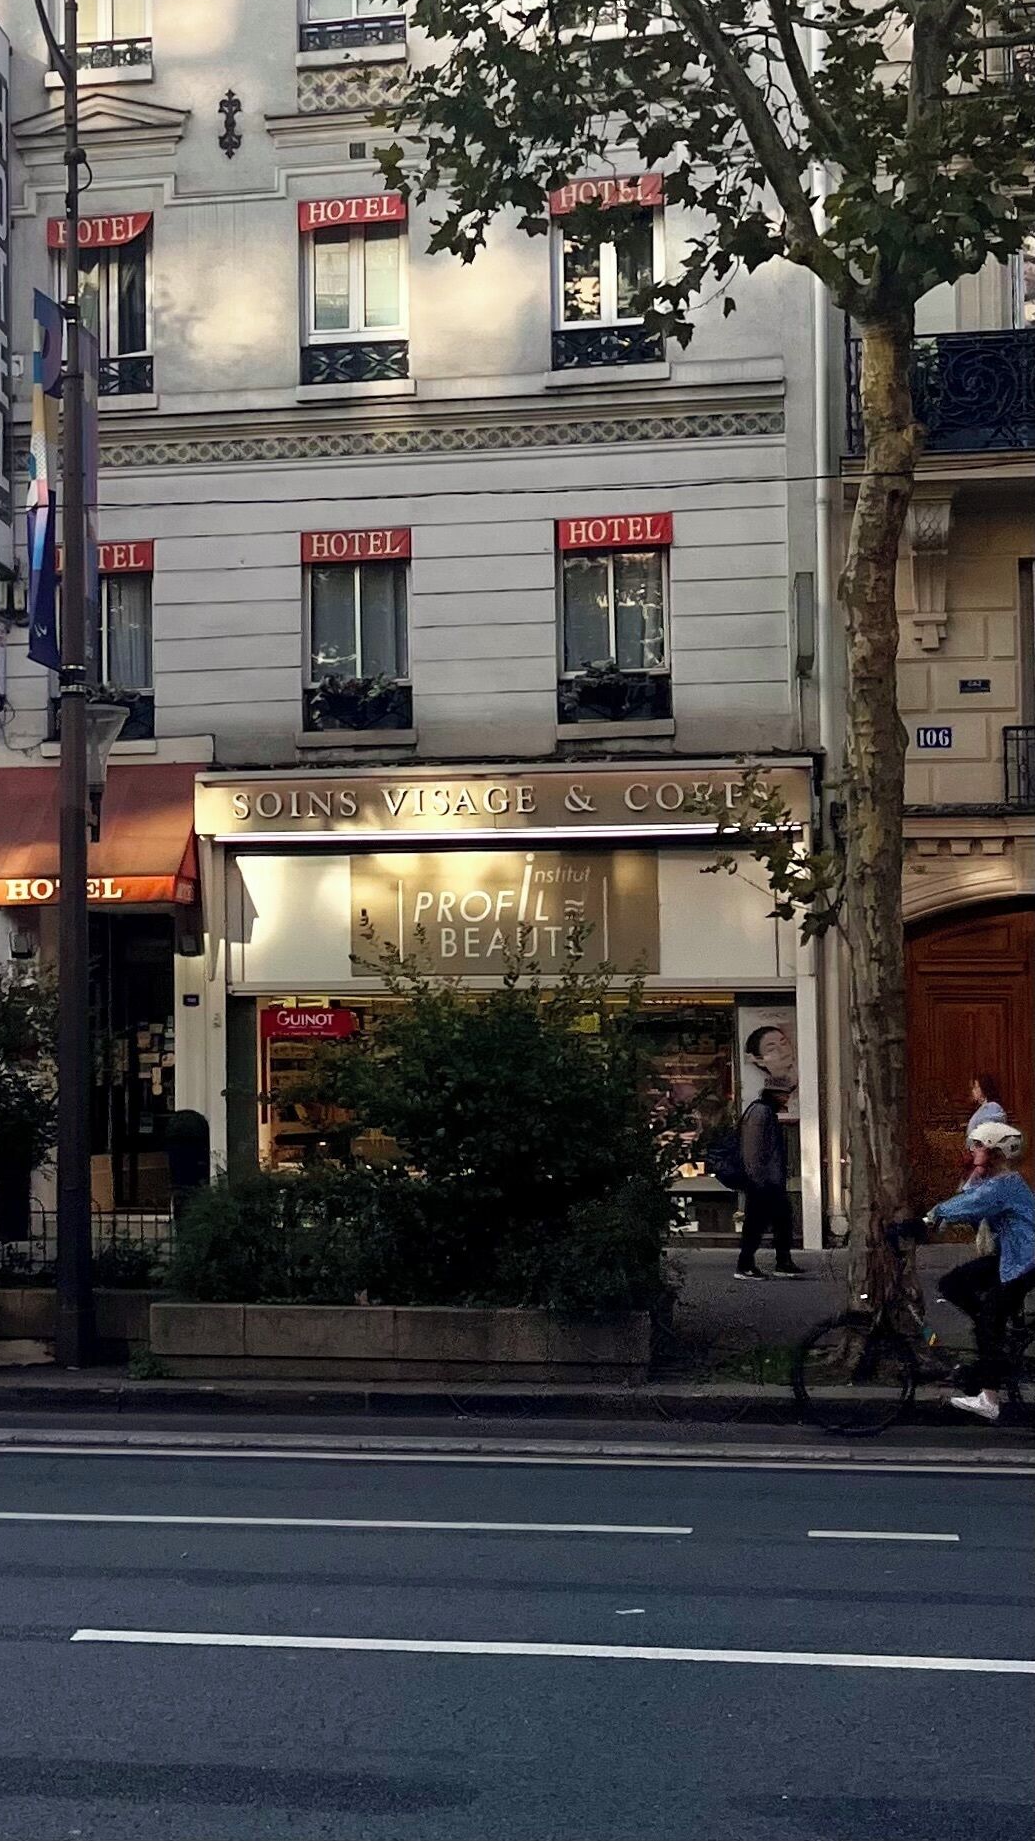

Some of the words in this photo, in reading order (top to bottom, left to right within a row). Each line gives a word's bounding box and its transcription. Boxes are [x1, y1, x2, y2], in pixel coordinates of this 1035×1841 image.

[308, 197, 396, 224] HOTEL
[568, 517, 661, 544] HOTEL
[311, 531, 401, 557] HOTEL
[919, 730, 950, 747] 106
[232, 790, 358, 820] SOINS
[380, 785, 539, 817] VISAGE
[564, 784, 598, 813] &
[6, 878, 122, 900] HOEL
[277, 1011, 334, 1026] GUINOT
